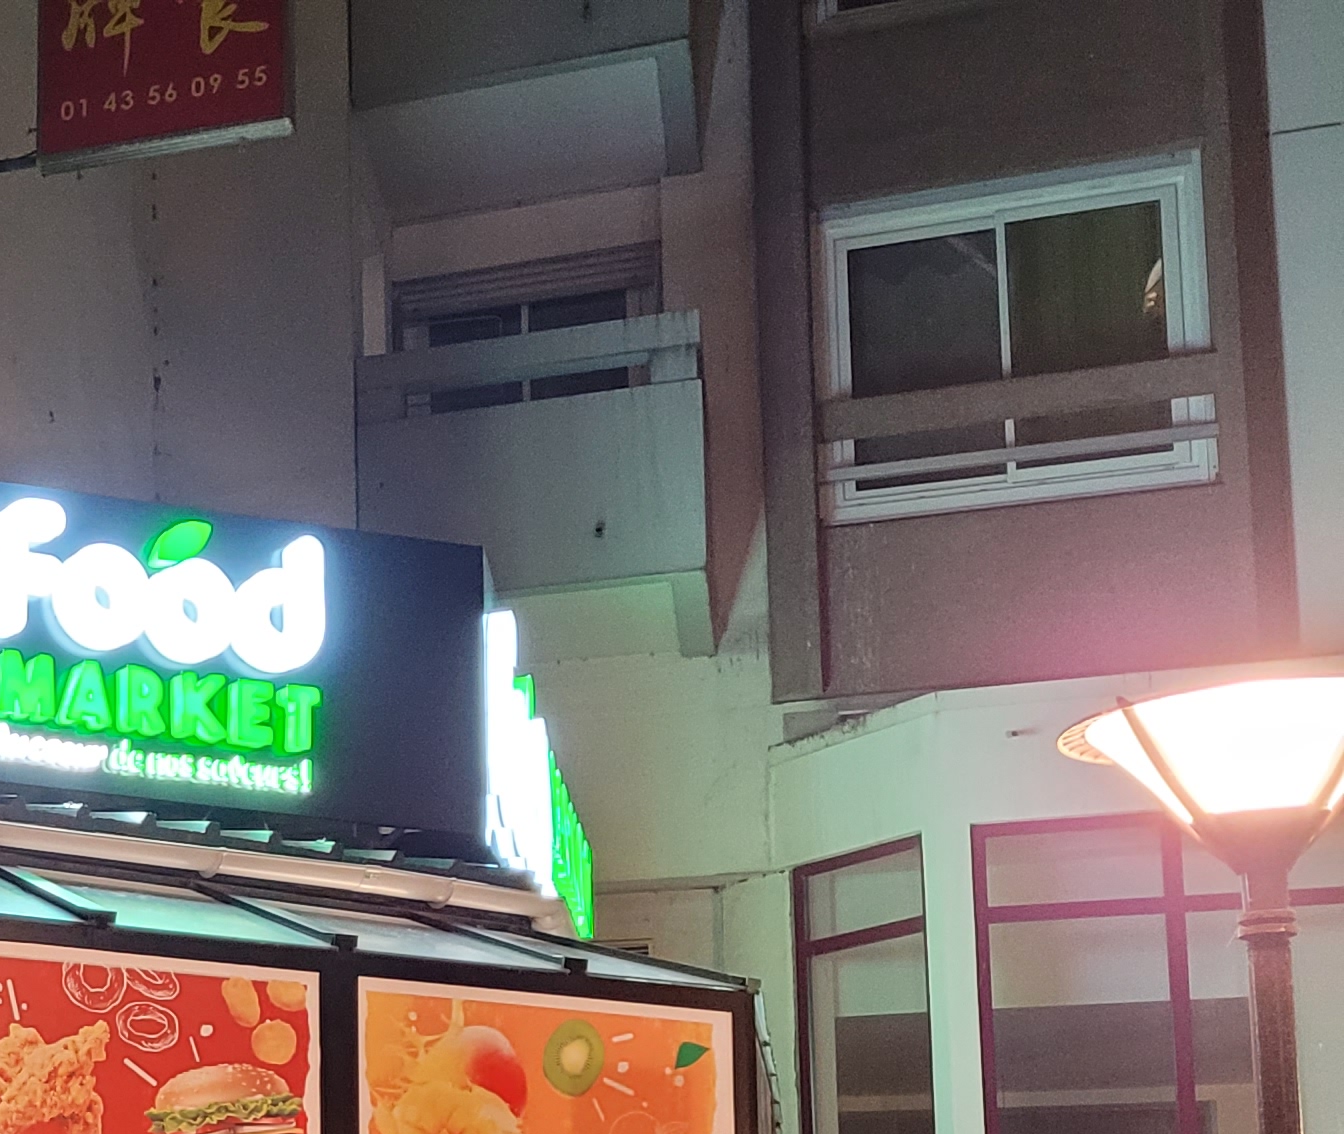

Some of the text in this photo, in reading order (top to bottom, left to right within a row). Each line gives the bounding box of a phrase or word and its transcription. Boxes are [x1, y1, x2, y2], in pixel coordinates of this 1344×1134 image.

[60, 65, 267, 121] 01 43 56 09 55
